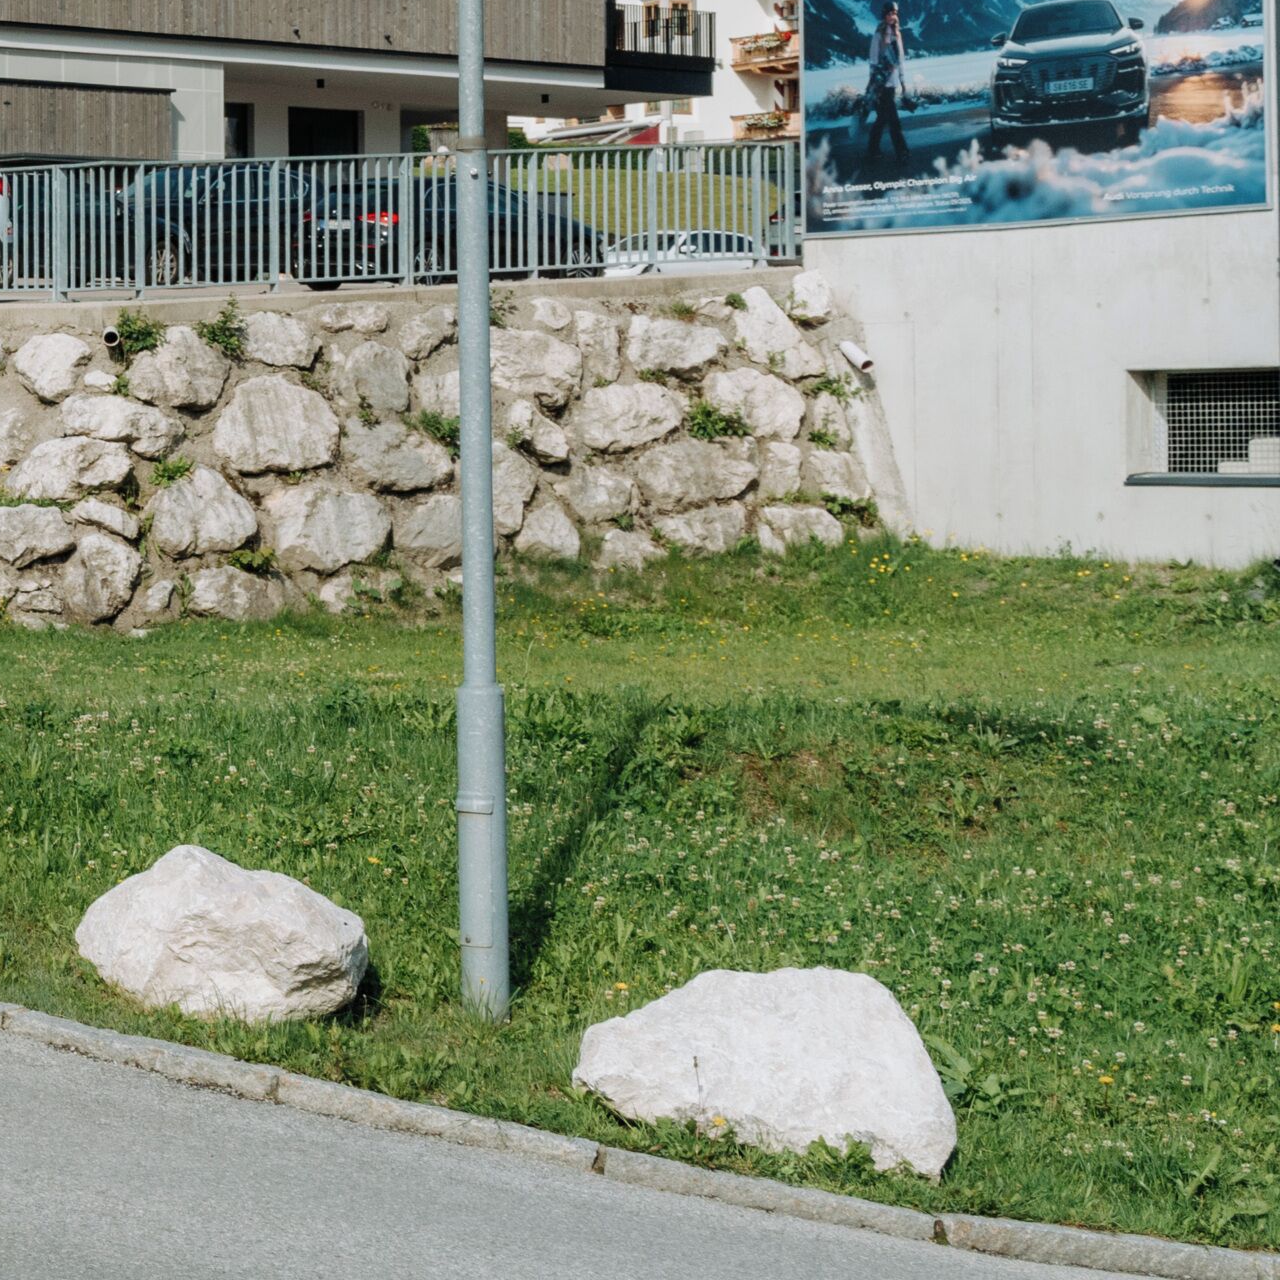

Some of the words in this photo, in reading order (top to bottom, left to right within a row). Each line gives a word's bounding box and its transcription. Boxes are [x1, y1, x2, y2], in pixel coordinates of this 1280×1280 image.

[822, 185, 844, 194] Anna
[873, 179, 906, 191] Olympic
[907, 176, 948, 188] Champion
[949, 175, 963, 185] Big
[964, 174, 978, 183] Air
[1103, 191, 1125, 201] Audi
[1125, 188, 1171, 200] Vorsprung
[1172, 186, 1199, 197] durch
[1200, 184, 1236, 194] Technik
